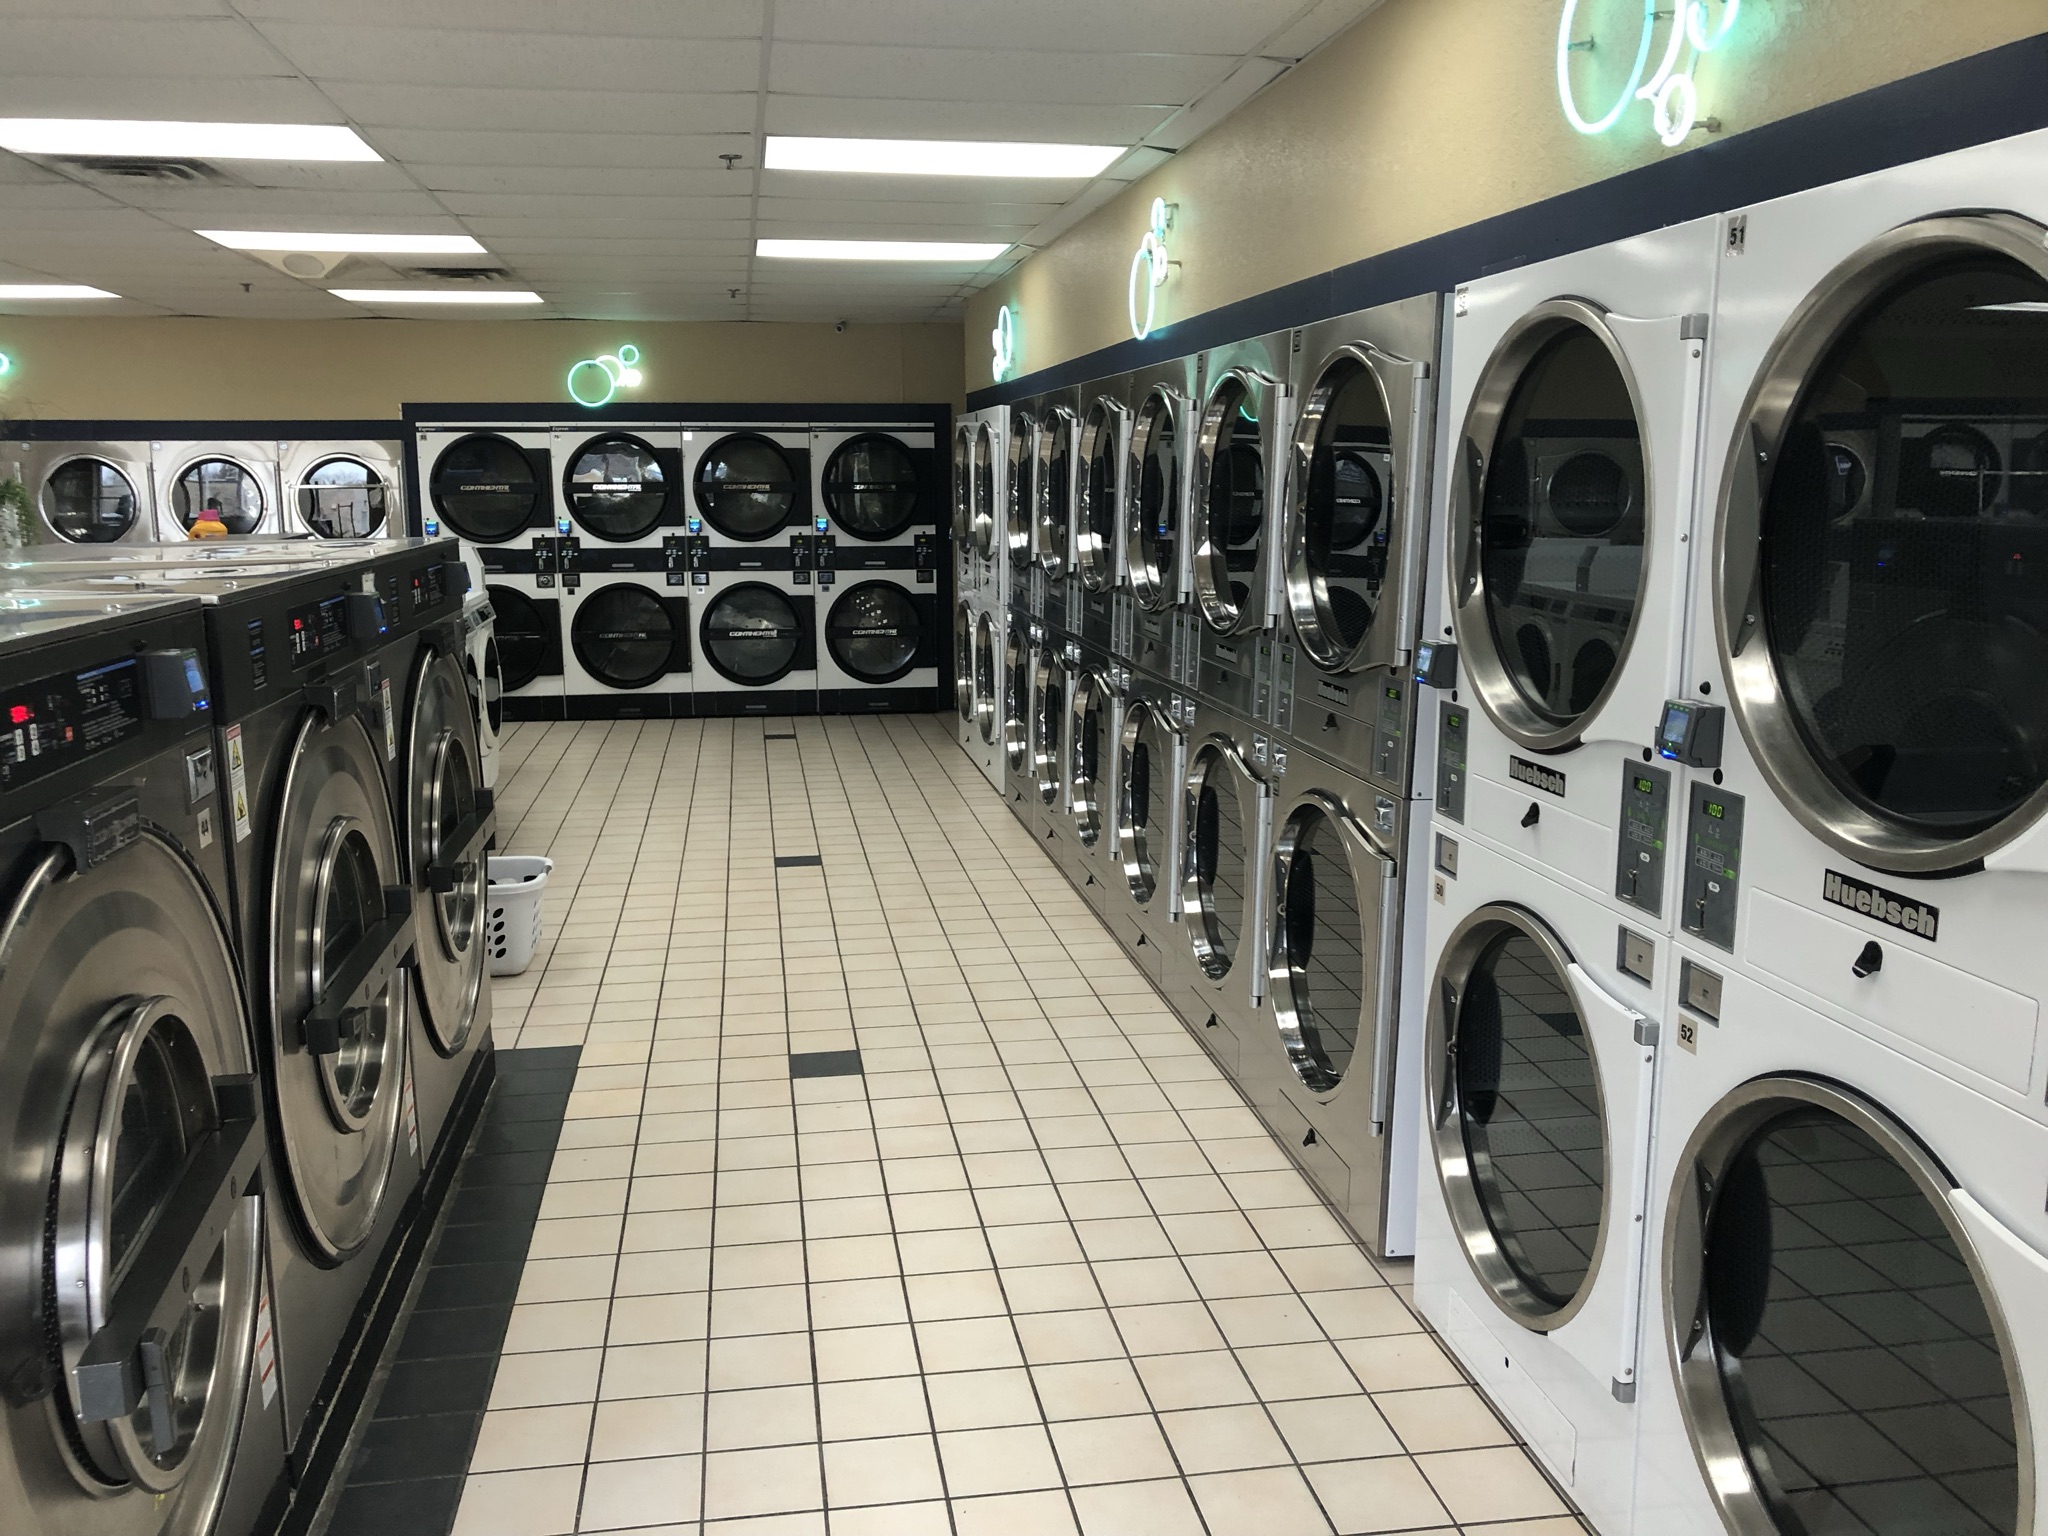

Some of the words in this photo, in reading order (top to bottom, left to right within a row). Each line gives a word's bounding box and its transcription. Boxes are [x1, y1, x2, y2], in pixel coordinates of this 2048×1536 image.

[1729, 226, 1744, 245] 51
[1510, 758, 1564, 794] Huebsch
[1639, 779, 1652, 793] 100
[1708, 803, 1723, 818] 100
[1435, 882, 1444, 898] 50
[1825, 873, 1935, 937] Huebsch
[1680, 1023, 1693, 1044] 52
